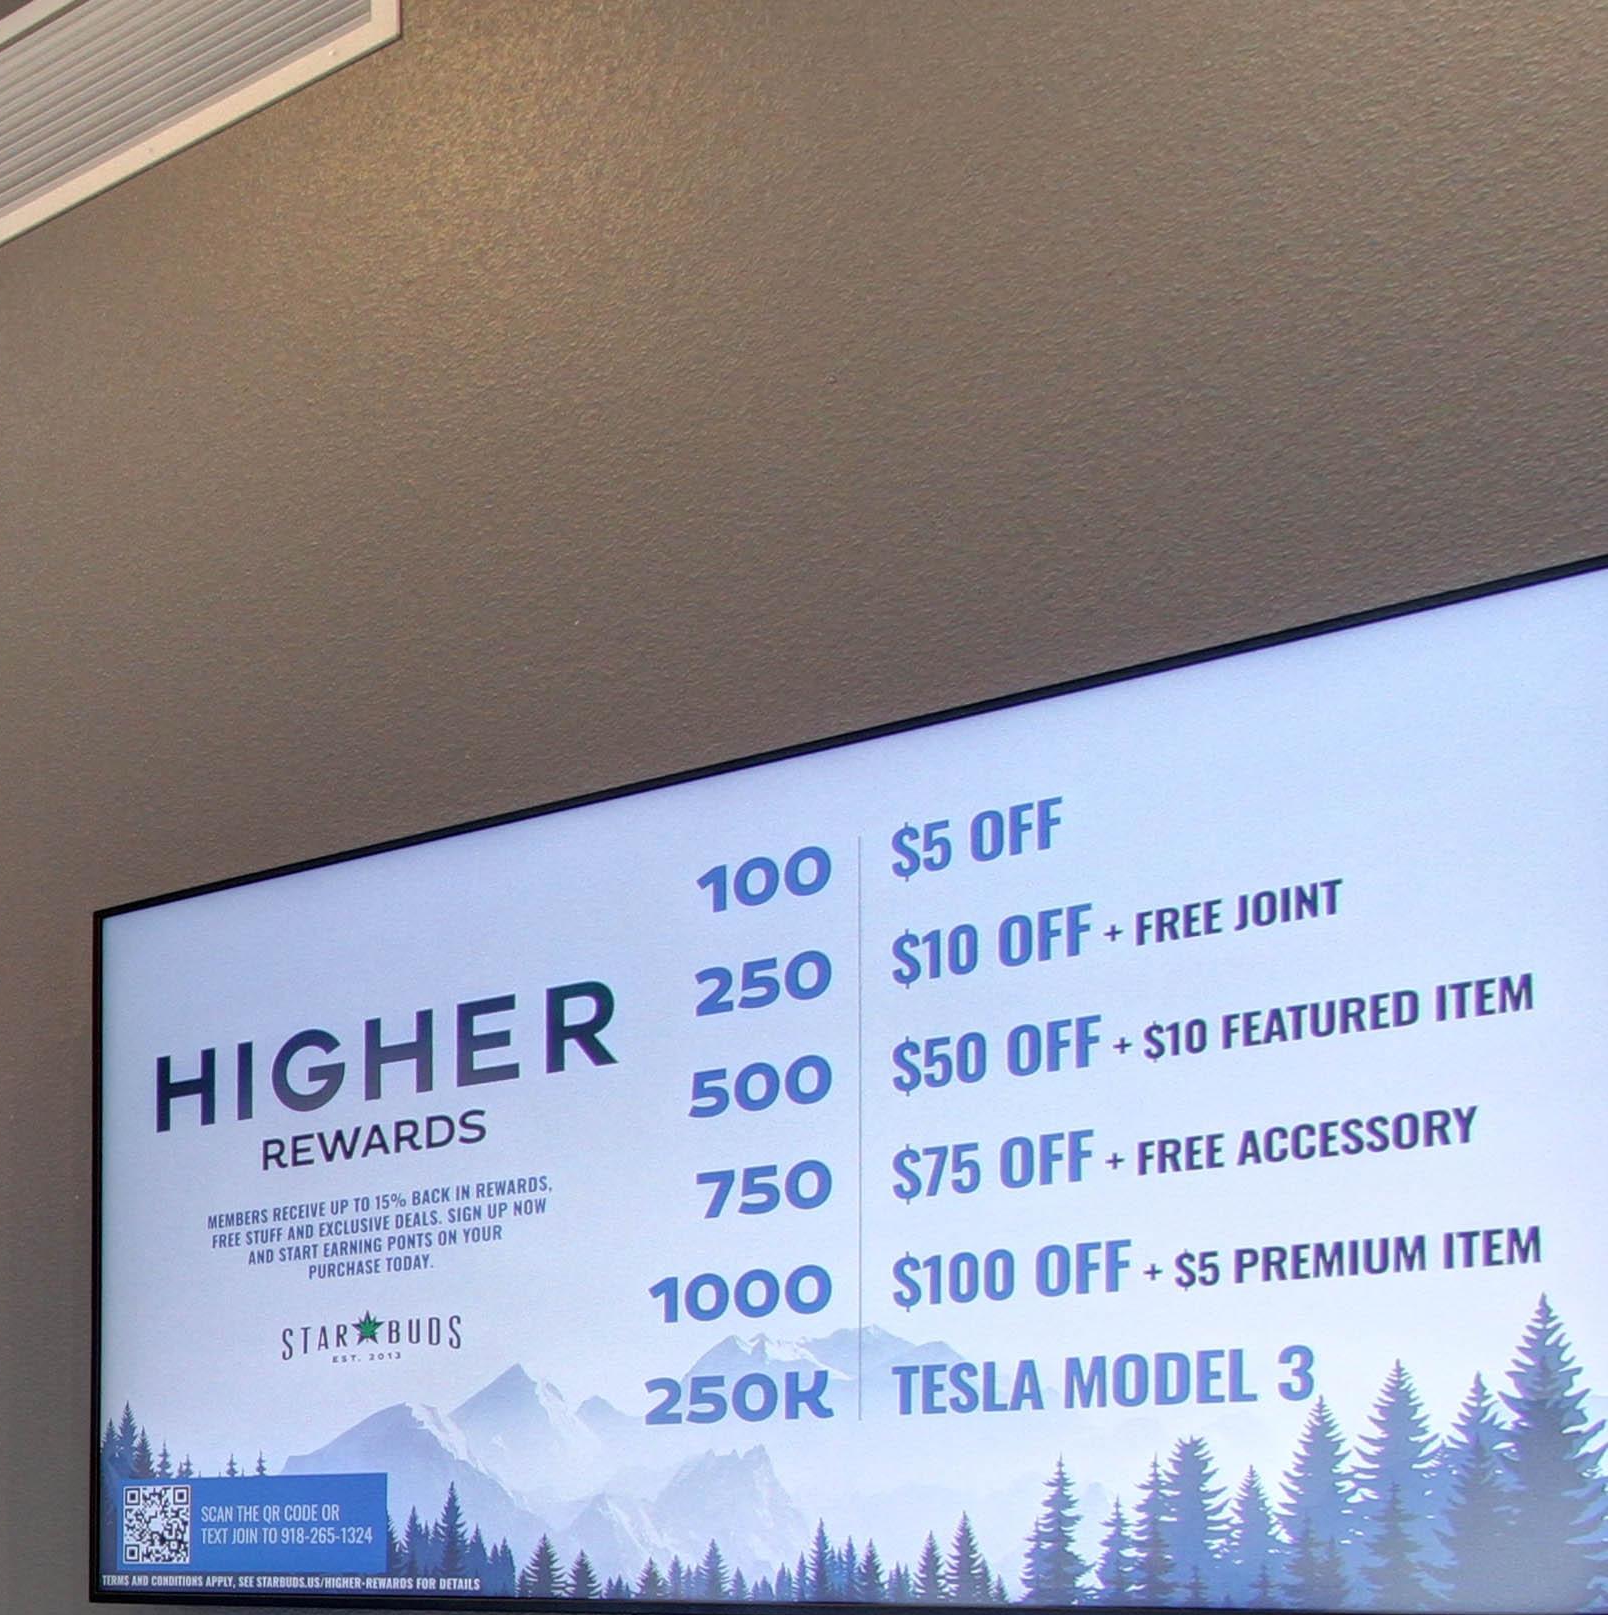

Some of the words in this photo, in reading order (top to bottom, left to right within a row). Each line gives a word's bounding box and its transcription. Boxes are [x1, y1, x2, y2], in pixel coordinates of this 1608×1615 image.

[891, 820, 952, 882] $5
[969, 796, 1063, 863] OFF
[696, 846, 832, 914] 100
[891, 924, 978, 990] $10
[997, 903, 1093, 968] OFF
[1135, 899, 1223, 946] FREE
[1234, 878, 1343, 932] JOINT
[695, 950, 832, 1017] 250
[155, 980, 620, 1133] HIGHER
[891, 1031, 987, 1097] $50
[1005, 1014, 1102, 1077] OFF
[1142, 1017, 1207, 1063] $10
[1221, 989, 1419, 1050] FEATURED
[1435, 972, 1534, 1022] ITEM
[688, 1055, 832, 1118] 500
[261, 1109, 487, 1171] REWARDS
[892, 1142, 982, 1205] $75
[1000, 1129, 1094, 1189] OFF
[1136, 1133, 1225, 1175] FREE
[1237, 1105, 1479, 1166] ACCESSORY
[207, 1210, 268, 1230] MEMBERS
[272, 1202, 326, 1222] RECEIVE
[330, 1200, 349, 1215] UP
[353, 1197, 370, 1213] TO
[375, 1192, 407, 1210] 15%
[412, 1186, 450, 1206] BACK
[455, 1184, 471, 1200] IN
[475, 1175, 553, 1198] REWARDS,
[695, 1159, 832, 1219] 750
[212, 1234, 242, 1249] FREE
[245, 1229, 283, 1246] STUFF
[287, 1225, 314, 1241] AND
[318, 1216, 390, 1238] EXCLUSIVE
[395, 1211, 442, 1229] DEALS.
[447, 1207, 482, 1224] SIGN
[487, 1203, 508, 1219] UP
[513, 1198, 547, 1217] NOW
[248, 1249, 274, 1266] AND
[278, 1245, 318, 1262] START
[323, 1238, 382, 1257] EARNING
[387, 1233, 432, 1251] PONTS
[438, 1230, 458, 1246] ON
[463, 1225, 503, 1244] YOUR
[308, 1259, 381, 1280] PURCHASE
[385, 1254, 434, 1273] TODAY.
[648, 1264, 832, 1323] 1000
[892, 1248, 1014, 1313] $100
[1035, 1238, 1133, 1297] OFF
[1174, 1248, 1220, 1291] $5
[1234, 1234, 1426, 1284] PREMIUM
[1443, 1225, 1542, 1269] ITEM
[282, 1323, 348, 1361] STAR
[388, 1315, 462, 1350] BUDS
[368, 1351, 402, 1361] 2013
[644, 1370, 834, 1425] 250K
[891, 1359, 1044, 1415] TESLA
[1064, 1348, 1258, 1409] MODEL
[1277, 1344, 1315, 1401] 3
[201, 1505, 233, 1523] SCAN
[237, 1505, 259, 1522] THE
[262, 1504, 281, 1523] QR
[284, 1504, 317, 1522] CODE
[322, 1504, 340, 1521] OR
[201, 1528, 229, 1545] TEXT
[231, 1527, 258, 1545] JOIN
[262, 1527, 277, 1545] TO
[281, 1527, 373, 1546] 918-265-1324
[102, 1575, 129, 1586] TERMS
[132, 1575, 149, 1587] AND
[151, 1576, 203, 1588] CONDITIONS
[206, 1576, 236, 1589] APPLY,
[239, 1577, 254, 1588] SEE
[416, 1578, 436, 1590] FOR
[439, 1578, 481, 1591] DETAILS
